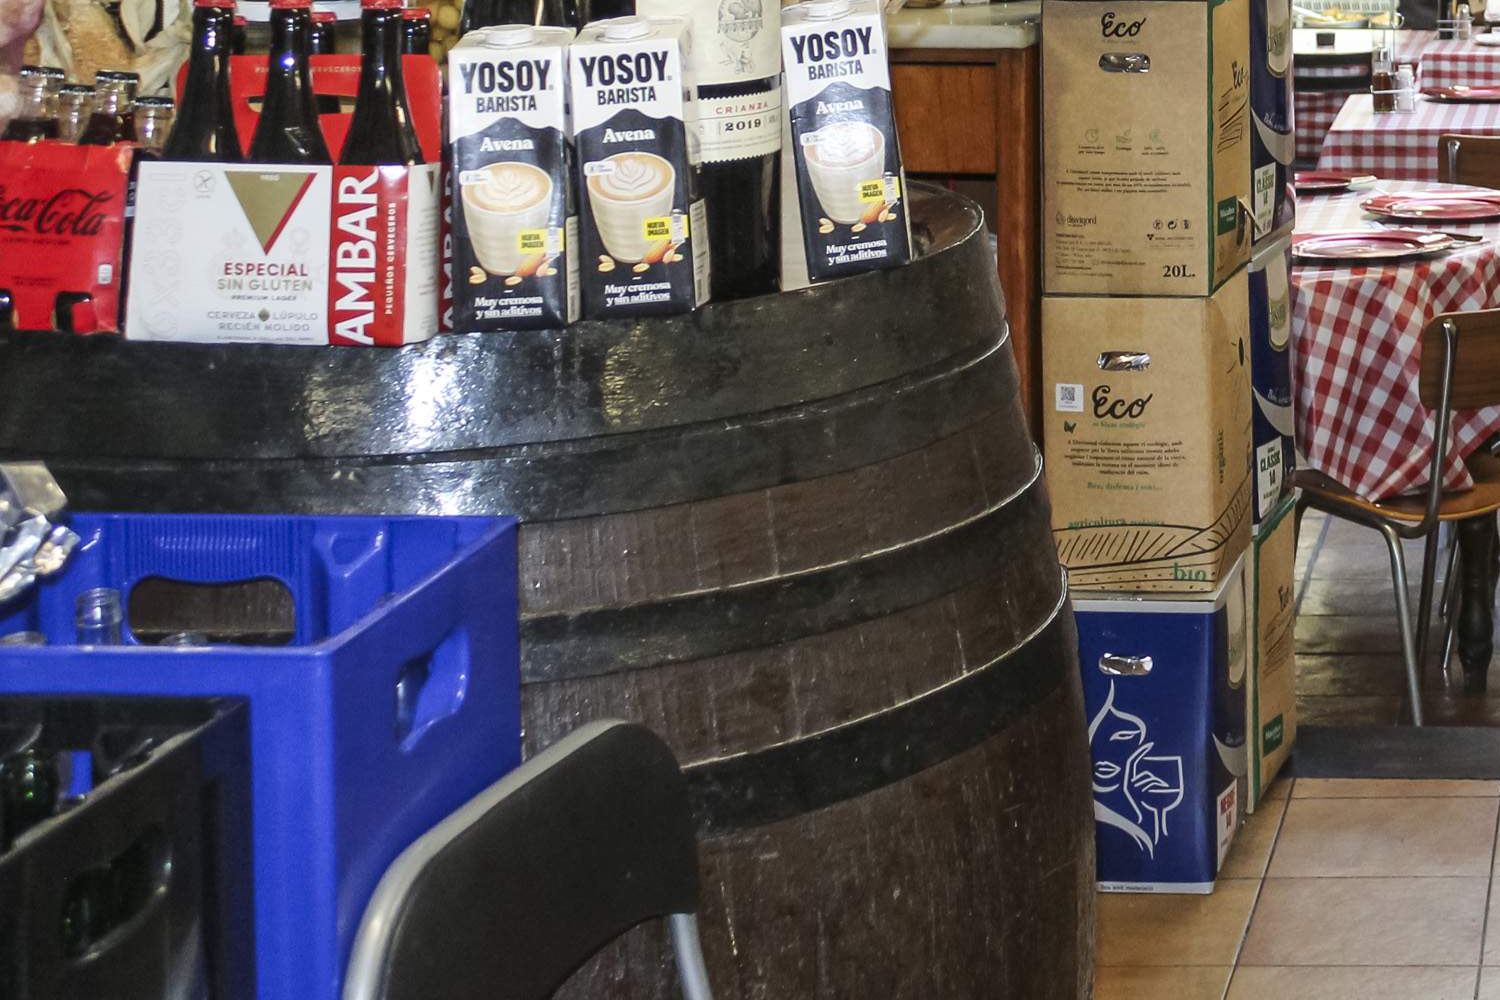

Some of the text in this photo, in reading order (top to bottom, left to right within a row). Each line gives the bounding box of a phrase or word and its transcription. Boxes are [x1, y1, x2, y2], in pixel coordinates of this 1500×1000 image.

[1101, 12, 1145, 37] Eco
[790, 26, 872, 64] YOSOY
[580, 51, 668, 86] YOSOY
[808, 60, 864, 80] BARISTA
[460, 60, 552, 94] YOSOY
[597, 86, 656, 105] BARISTA
[476, 96, 537, 113] BARISTA
[715, 101, 768, 114] CRIANZA
[816, 99, 864, 115] Avena
[725, 118, 761, 131] 2019
[602, 127, 656, 144] Avena
[480, 137, 534, 152] Avena
[826, 240, 887, 256] Muy cremosa
[335, 167, 379, 345] AMBAR
[224, 262, 308, 276] ESPECIAL
[1162, 264, 1195, 278] 20L.
[217, 279, 312, 291] SIN GLUTEN
[604, 282, 671, 297] Muy cremosa
[474, 296, 543, 310] Muy cremosa
[615, 294, 629, 305] sin
[631, 291, 670, 303] aditivos
[207, 310, 318, 321] CERVEZA LÚPULO
[485, 307, 500, 318] sin
[501, 305, 542, 317] aditivos
[218, 322, 310, 332] RECIÉN MOLIDO
[1092, 384, 1153, 419] Eco
